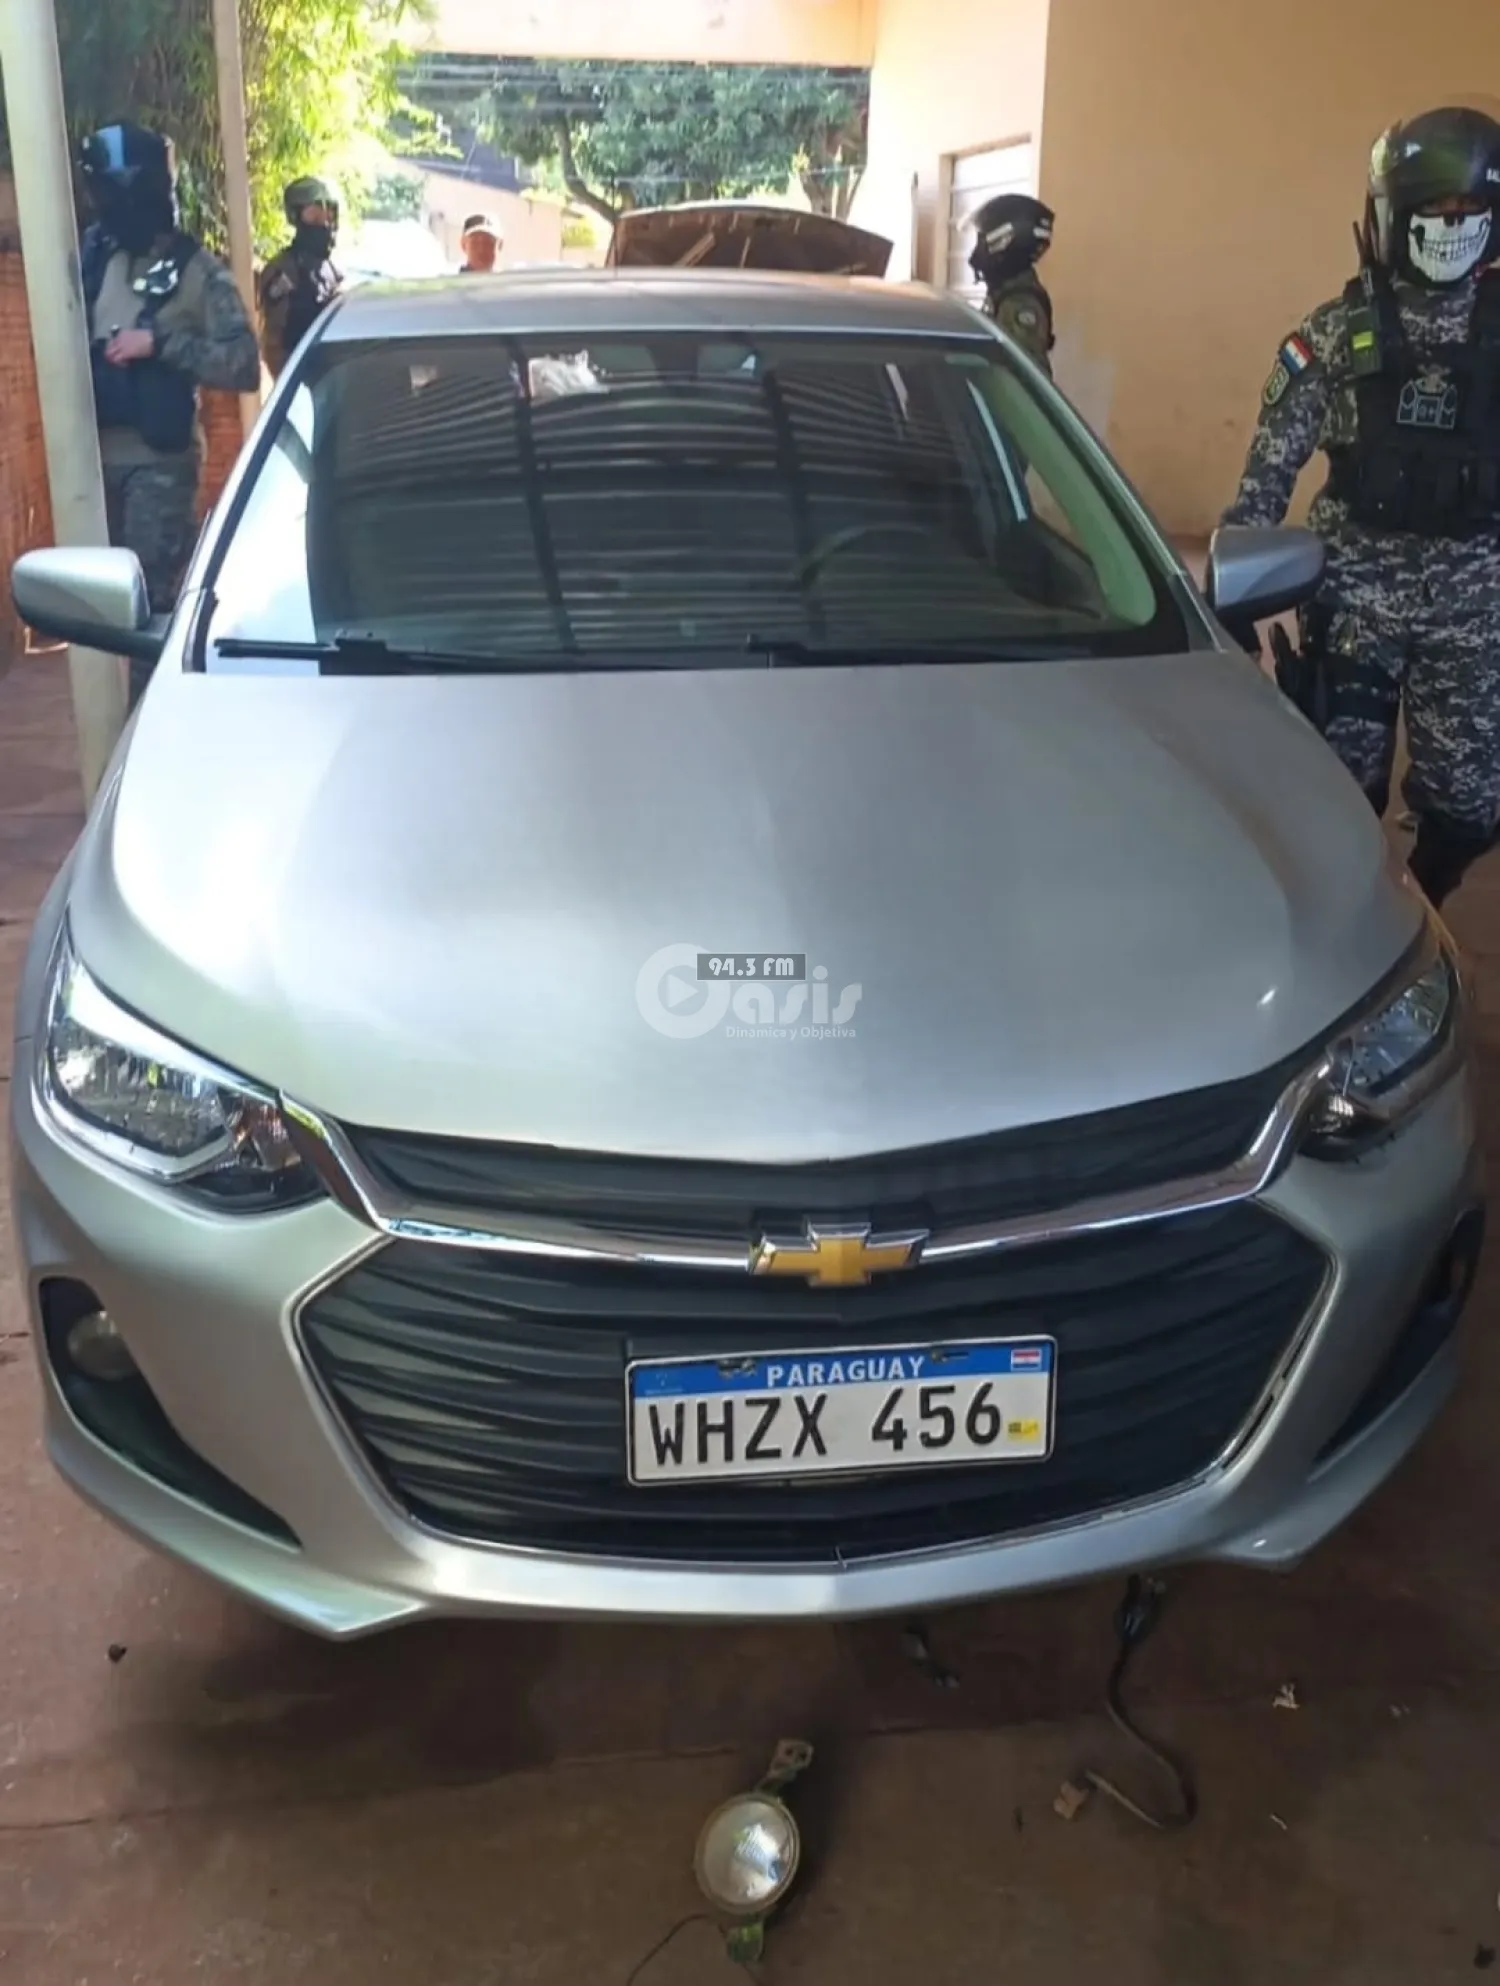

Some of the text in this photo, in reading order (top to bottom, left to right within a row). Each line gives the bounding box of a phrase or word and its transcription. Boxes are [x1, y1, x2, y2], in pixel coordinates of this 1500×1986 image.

[766, 1355, 925, 1388] PARAGUAY
[648, 1382, 1000, 1465] WHZX 456
